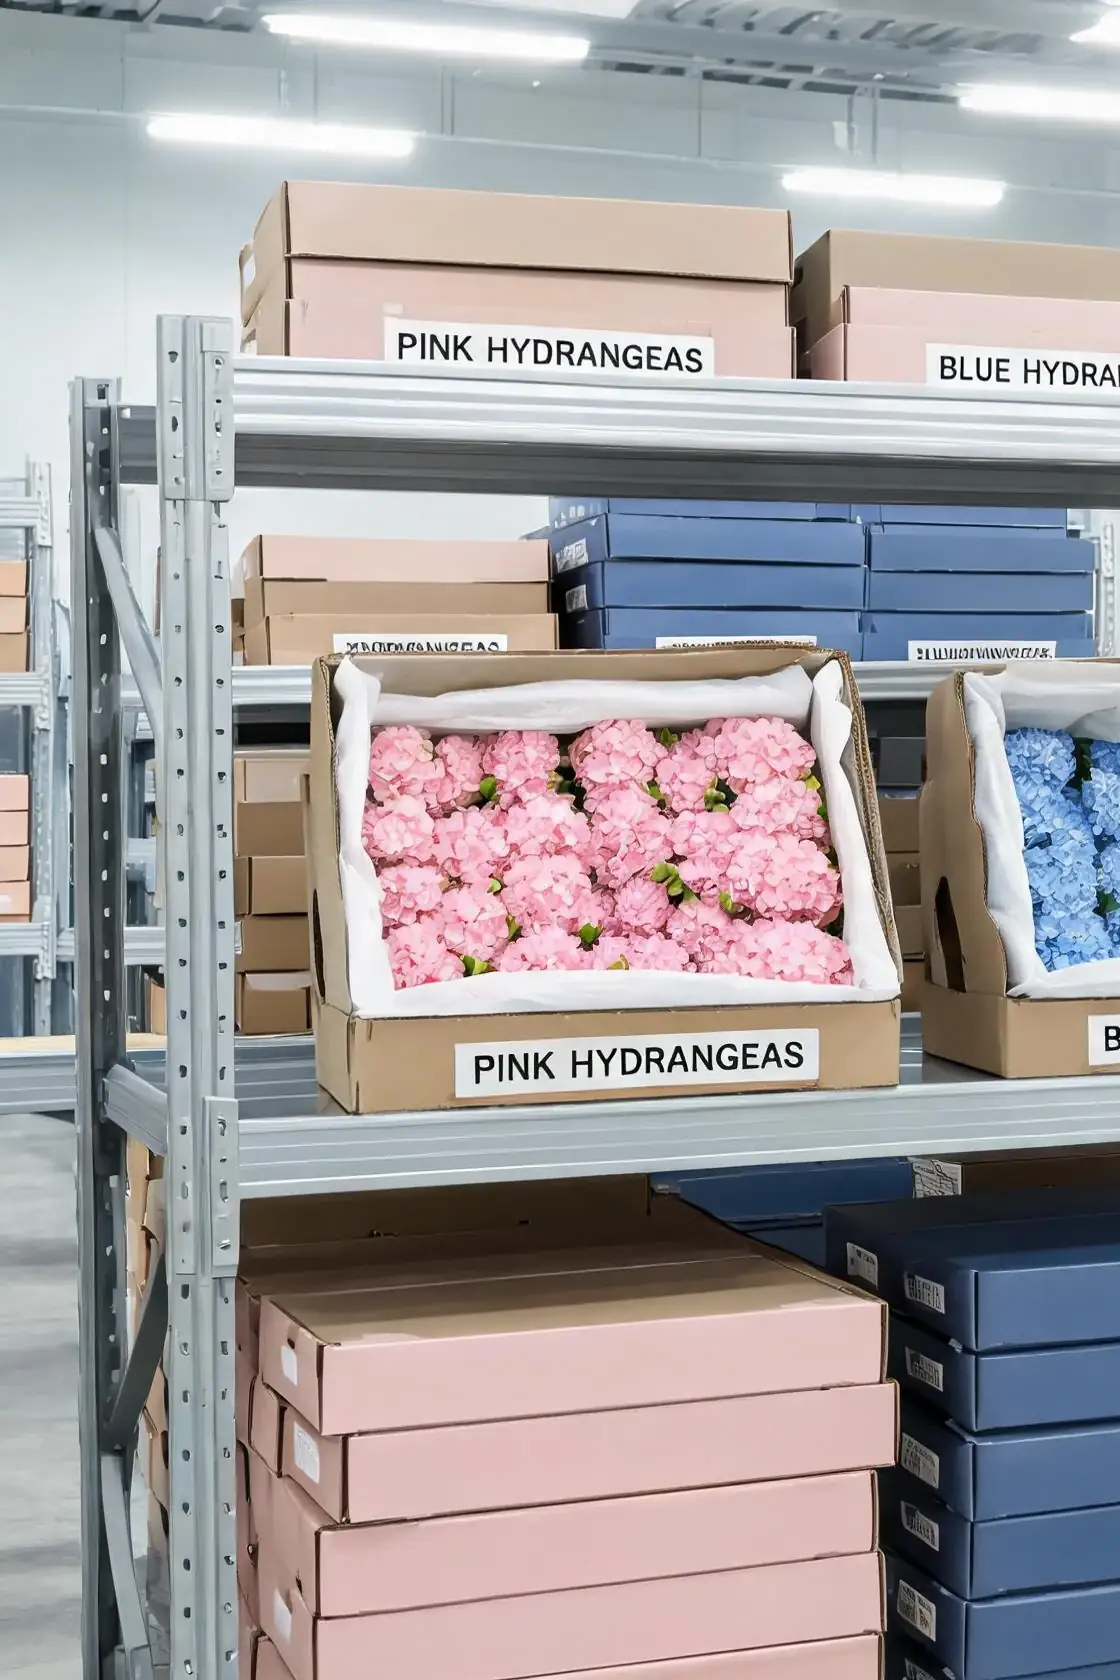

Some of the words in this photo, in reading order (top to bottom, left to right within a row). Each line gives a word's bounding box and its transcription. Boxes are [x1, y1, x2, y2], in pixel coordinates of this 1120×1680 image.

[398, 332, 474, 362] PINK
[487, 336, 704, 373] HYDRANGEAS
[940, 355, 1010, 381] BLUE
[474, 1051, 556, 1085] PINK
[571, 1041, 804, 1079] HYDRANGEAS
